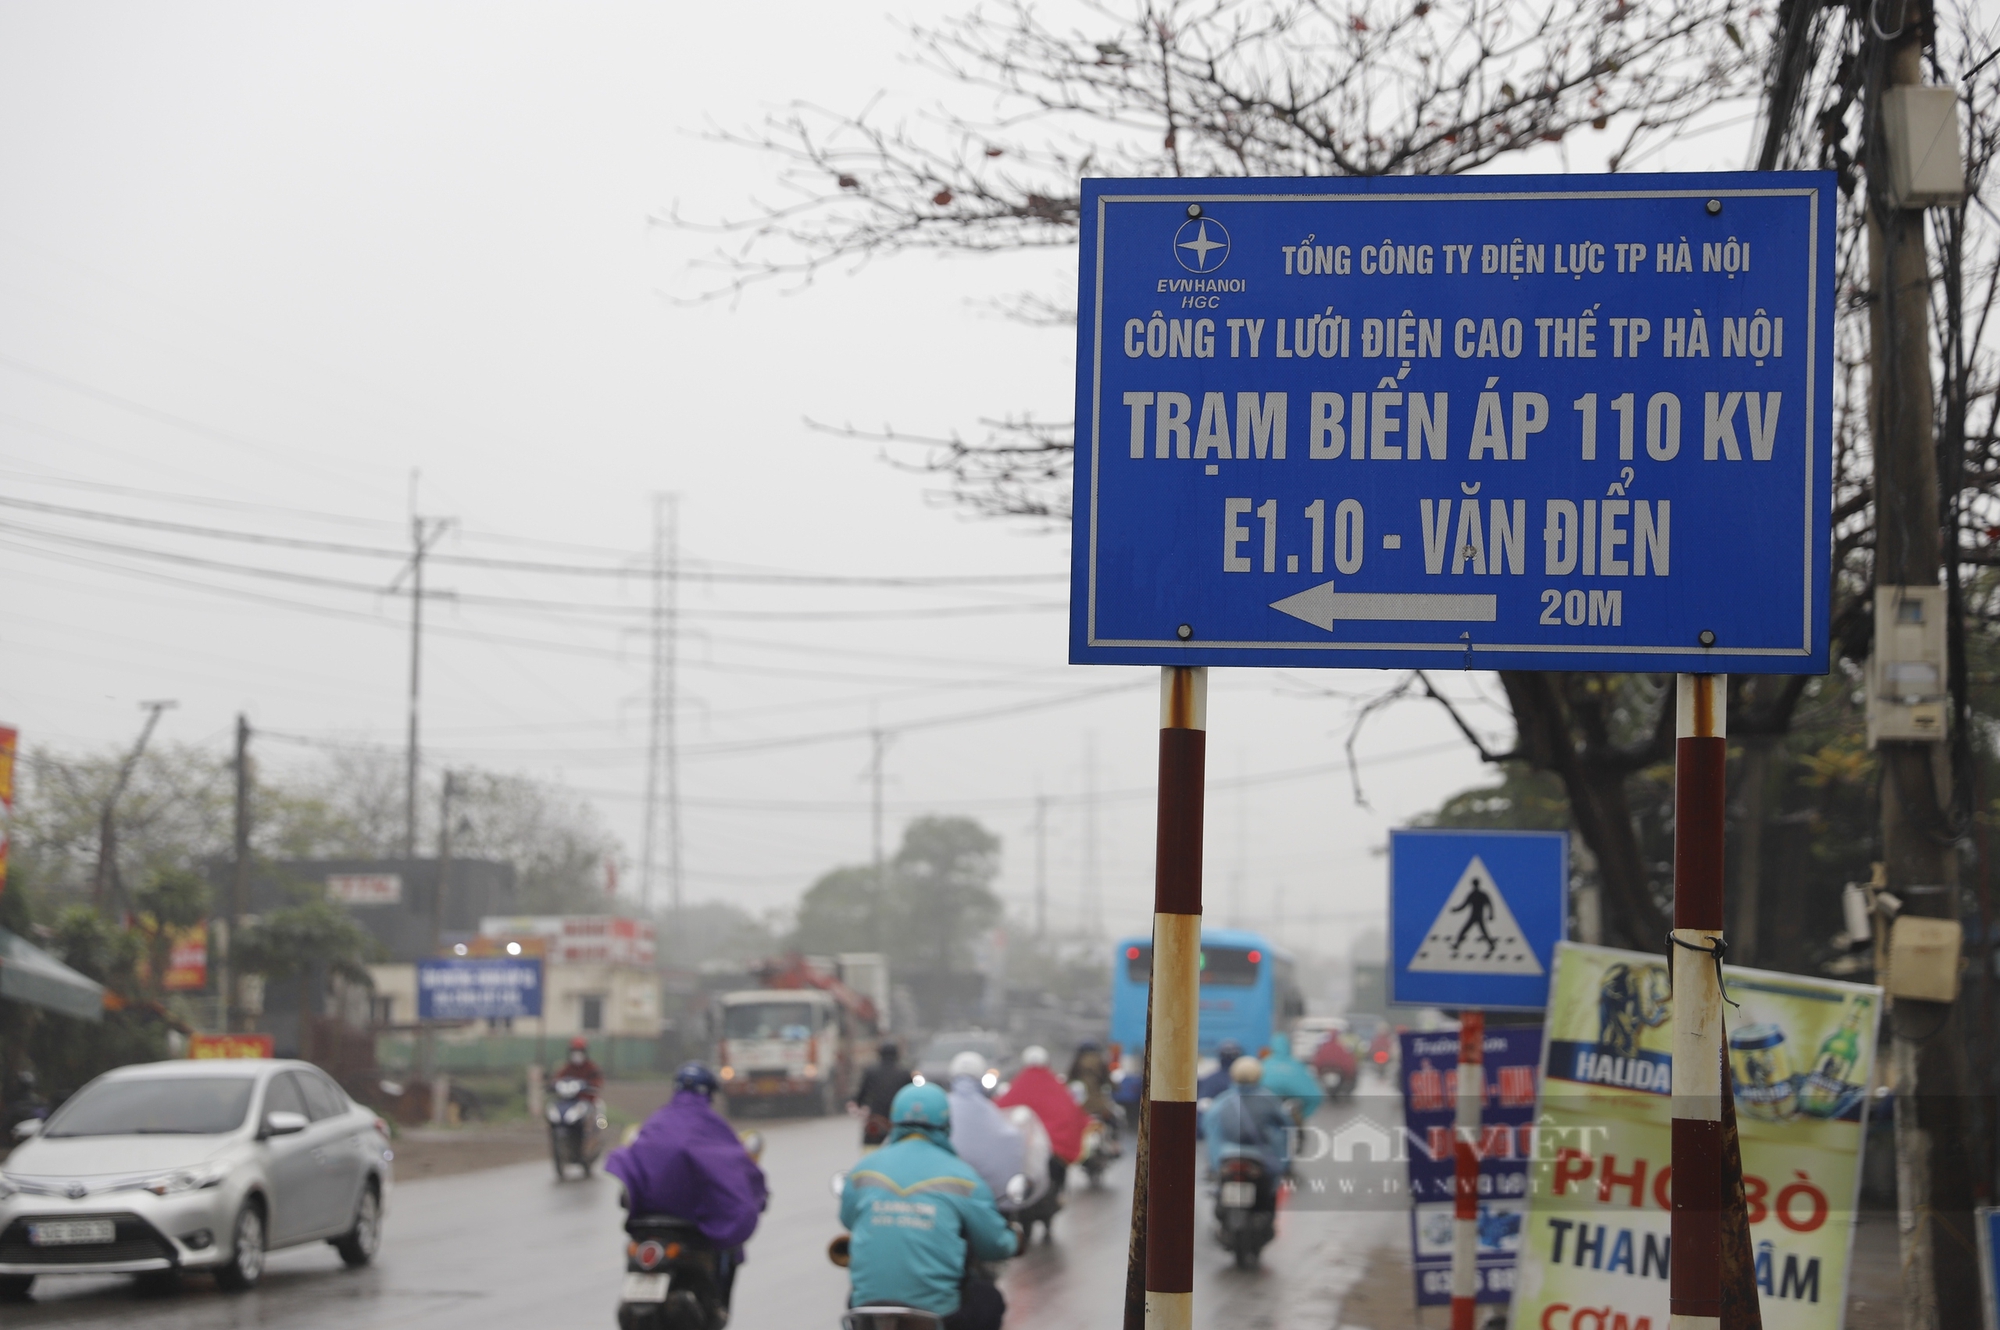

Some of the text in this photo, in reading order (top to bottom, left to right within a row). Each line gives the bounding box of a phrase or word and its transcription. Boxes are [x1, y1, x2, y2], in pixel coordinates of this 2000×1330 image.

[1282, 233, 1750, 281] TỔNG CÔNG TY ĐIỆN LỰC TP HÀ NỘI
[1157, 279, 1246, 293] EVNHANOI
[1181, 296, 1220, 309] HGC
[1124, 303, 1783, 367] CÔNG TY LƯỚI ĐIỆN CAO THẾ TP HÀ NỘI
[1122, 368, 1782, 476] TRẠM BIẾN ÁP 110 KV
[1223, 466, 1671, 576] E1.10 - VĂN ĐIỂN
[1539, 589, 1622, 627] 20M
[1576, 1051, 1671, 1093] HALIDA
